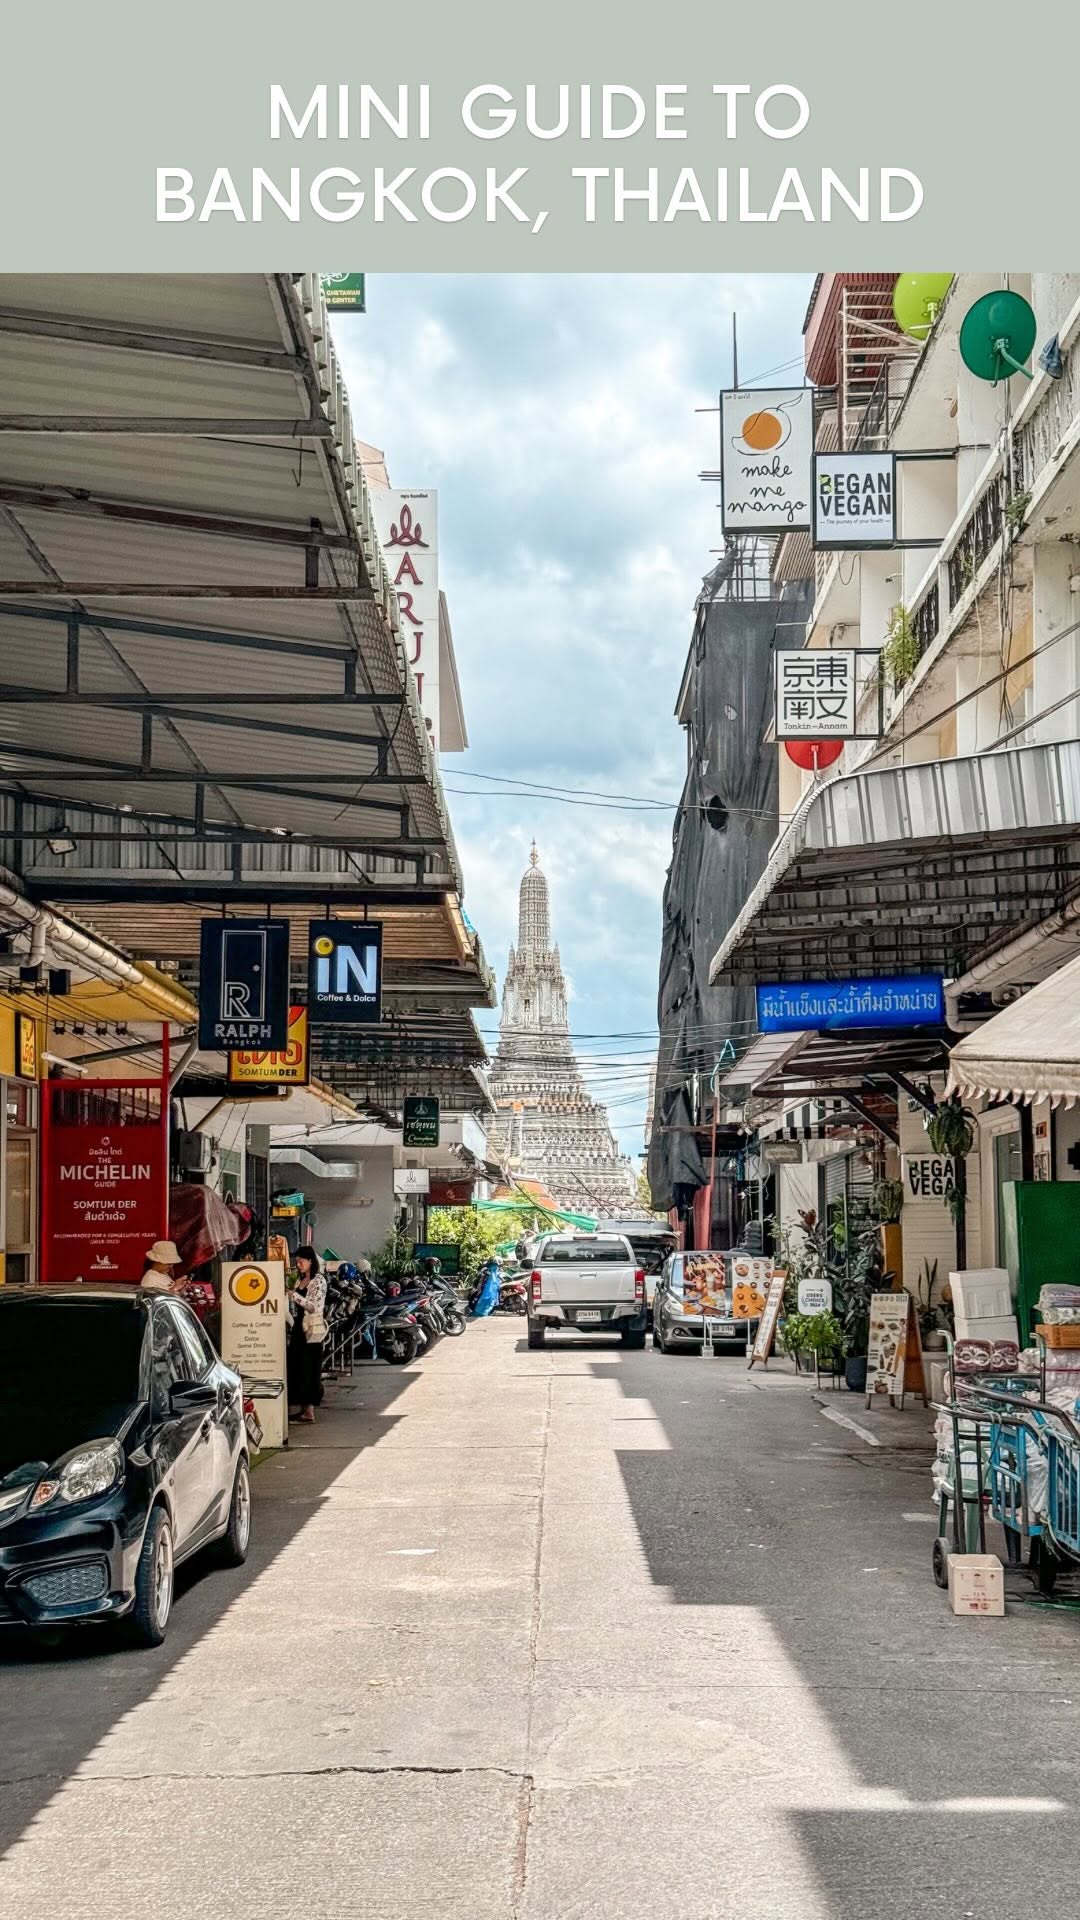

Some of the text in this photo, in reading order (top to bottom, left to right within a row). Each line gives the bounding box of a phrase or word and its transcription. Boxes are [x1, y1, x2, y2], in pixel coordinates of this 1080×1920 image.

[741, 456, 793, 479] make
[819, 472, 891, 495] BEGAN
[750, 485, 786, 498] me
[727, 500, 808, 523] mango
[820, 494, 892, 517] VEGAN
[317, 993, 377, 1002] Coffee & Dolce
[214, 1024, 272, 1038] RALPH
[222, 1038, 262, 1046] Bangkok
[98, 1156, 112, 1164] THE
[60, 1164, 151, 1180] MICHELIN
[908, 1159, 956, 1178] BEGA
[73, 1200, 137, 1209] SOMTUM DER
[84, 1210, 126, 1221] ส้มตำเด้อ
